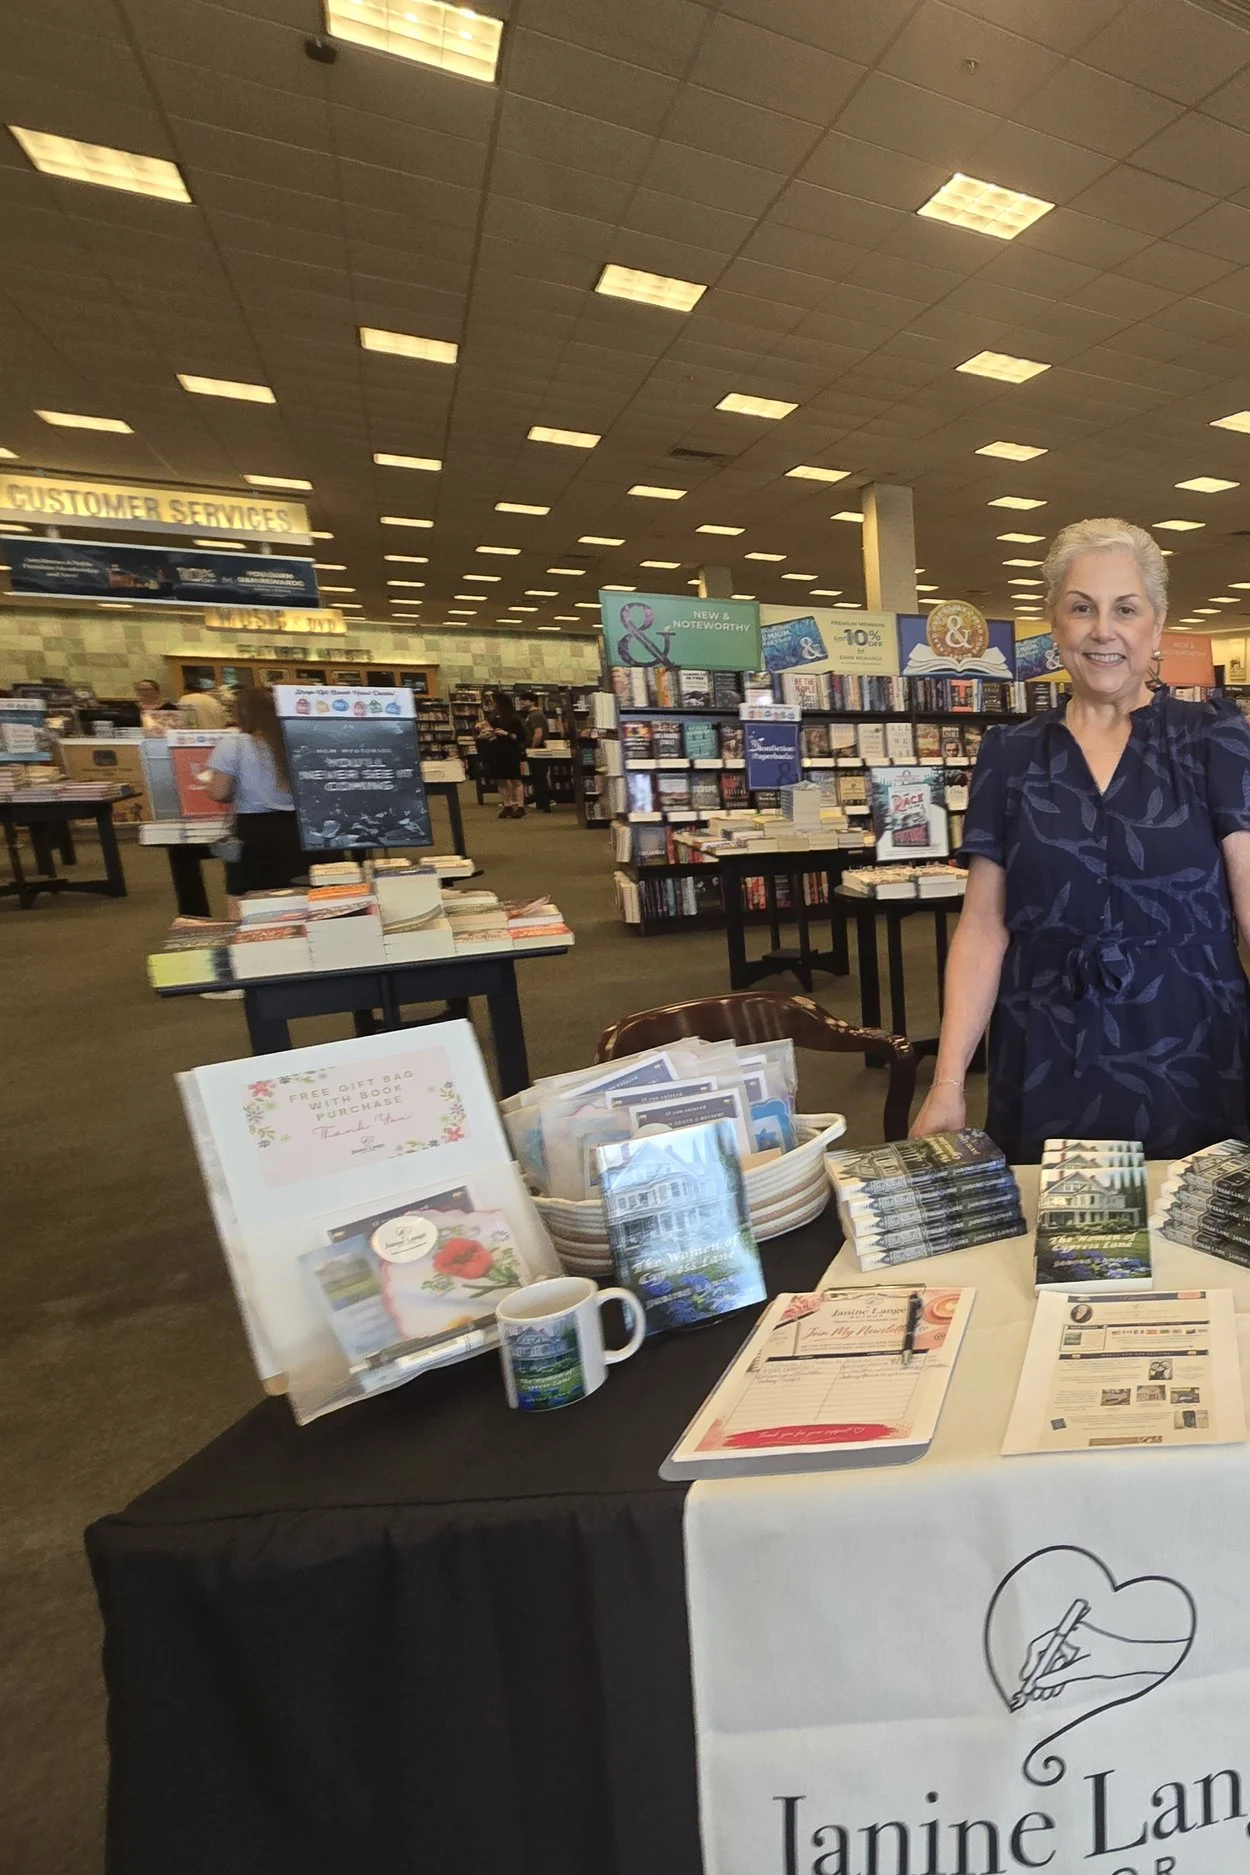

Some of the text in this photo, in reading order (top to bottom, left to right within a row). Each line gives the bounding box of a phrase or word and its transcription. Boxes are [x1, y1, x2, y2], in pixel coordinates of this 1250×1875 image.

[6, 483, 293, 532] CUSTOMER SERVICES
[693, 610, 730, 621] NEW &
[673, 620, 750, 632] NOTEWORTHY
[945, 615, 973, 648] &
[298, 769, 359, 780] NEVER
[360, 769, 395, 779] SEE
[323, 781, 395, 792] COMING
[288, 1070, 414, 1103] FREE GIFT BAG
[308, 1083, 403, 1111] WITH BOOK
[316, 1095, 403, 1122] PURCHASE
[311, 1112, 413, 1140] Thank You
[1048, 1231, 1139, 1245] The Women of
[1232, 1234, 1250, 1246] JANINE
[631, 1231, 741, 1275] The Women of
[1050, 1241, 1133, 1254] Cypress Lane
[703, 1249, 738, 1267] Lane
[1228, 1252, 1248, 1264] JANINE
[831, 1306, 907, 1318] Janine Lange
[801, 1326, 831, 1341] Join
[831, 1326, 854, 1340] My
[773, 1790, 1057, 1875] Janine
